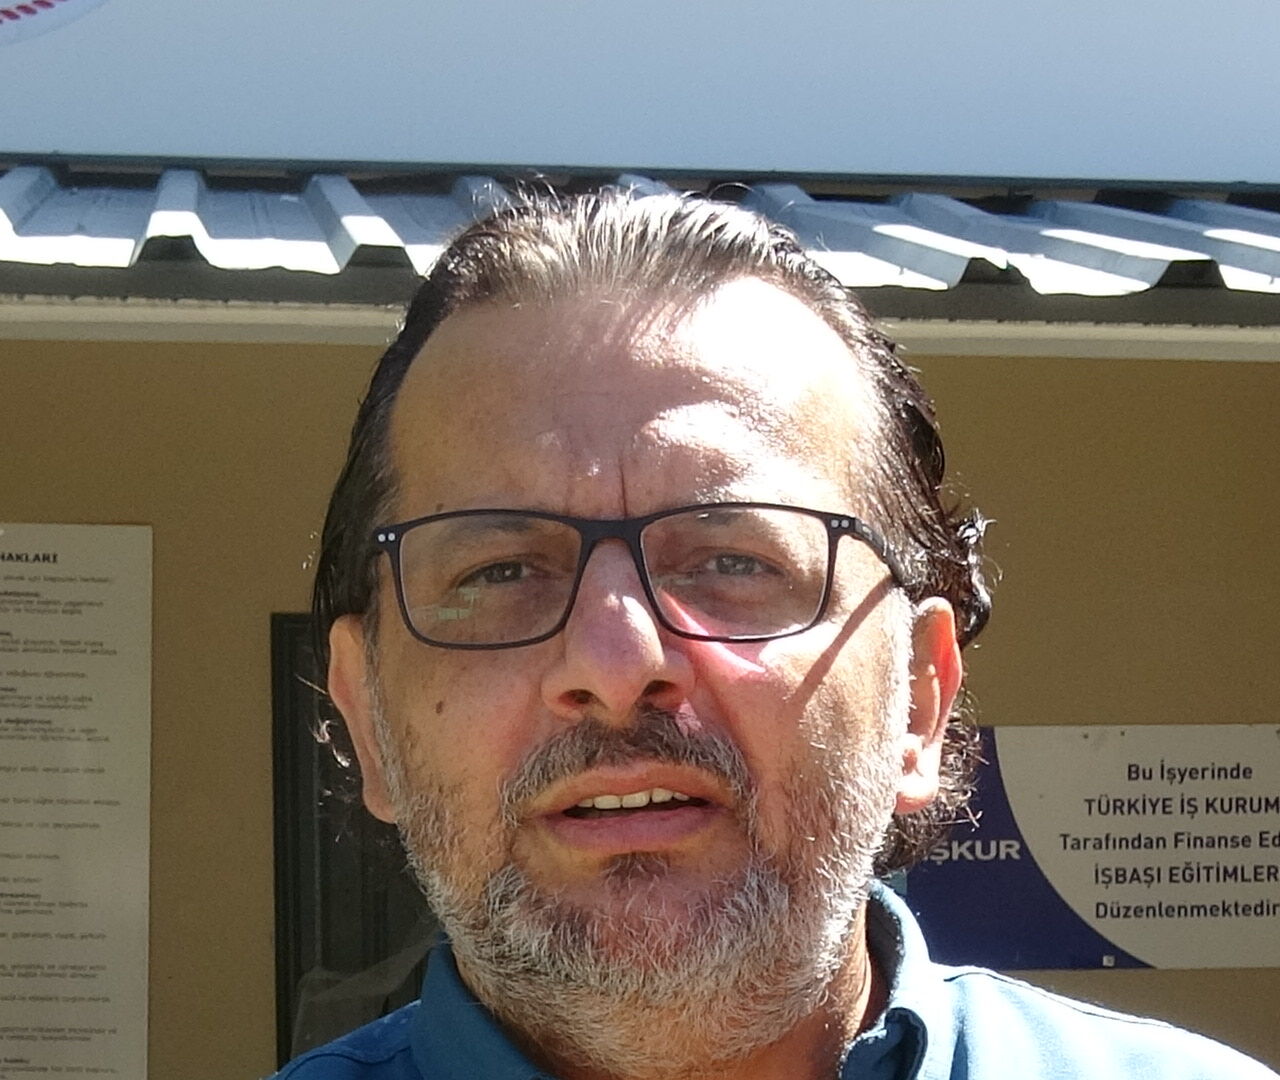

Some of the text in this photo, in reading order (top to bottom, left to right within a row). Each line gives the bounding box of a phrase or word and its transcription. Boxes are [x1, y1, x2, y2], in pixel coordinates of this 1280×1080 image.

[1127, 759, 1253, 785] Bu İşyerinde
[1084, 794, 1173, 816] TÜRKİYE
[1180, 793, 1198, 819] İŞ
[923, 839, 1021, 866] ŞKUR
[1060, 832, 1167, 850] Tarafından
[1174, 831, 1252, 849] Finanse
[1094, 863, 1162, 889] İŞBAŞI
